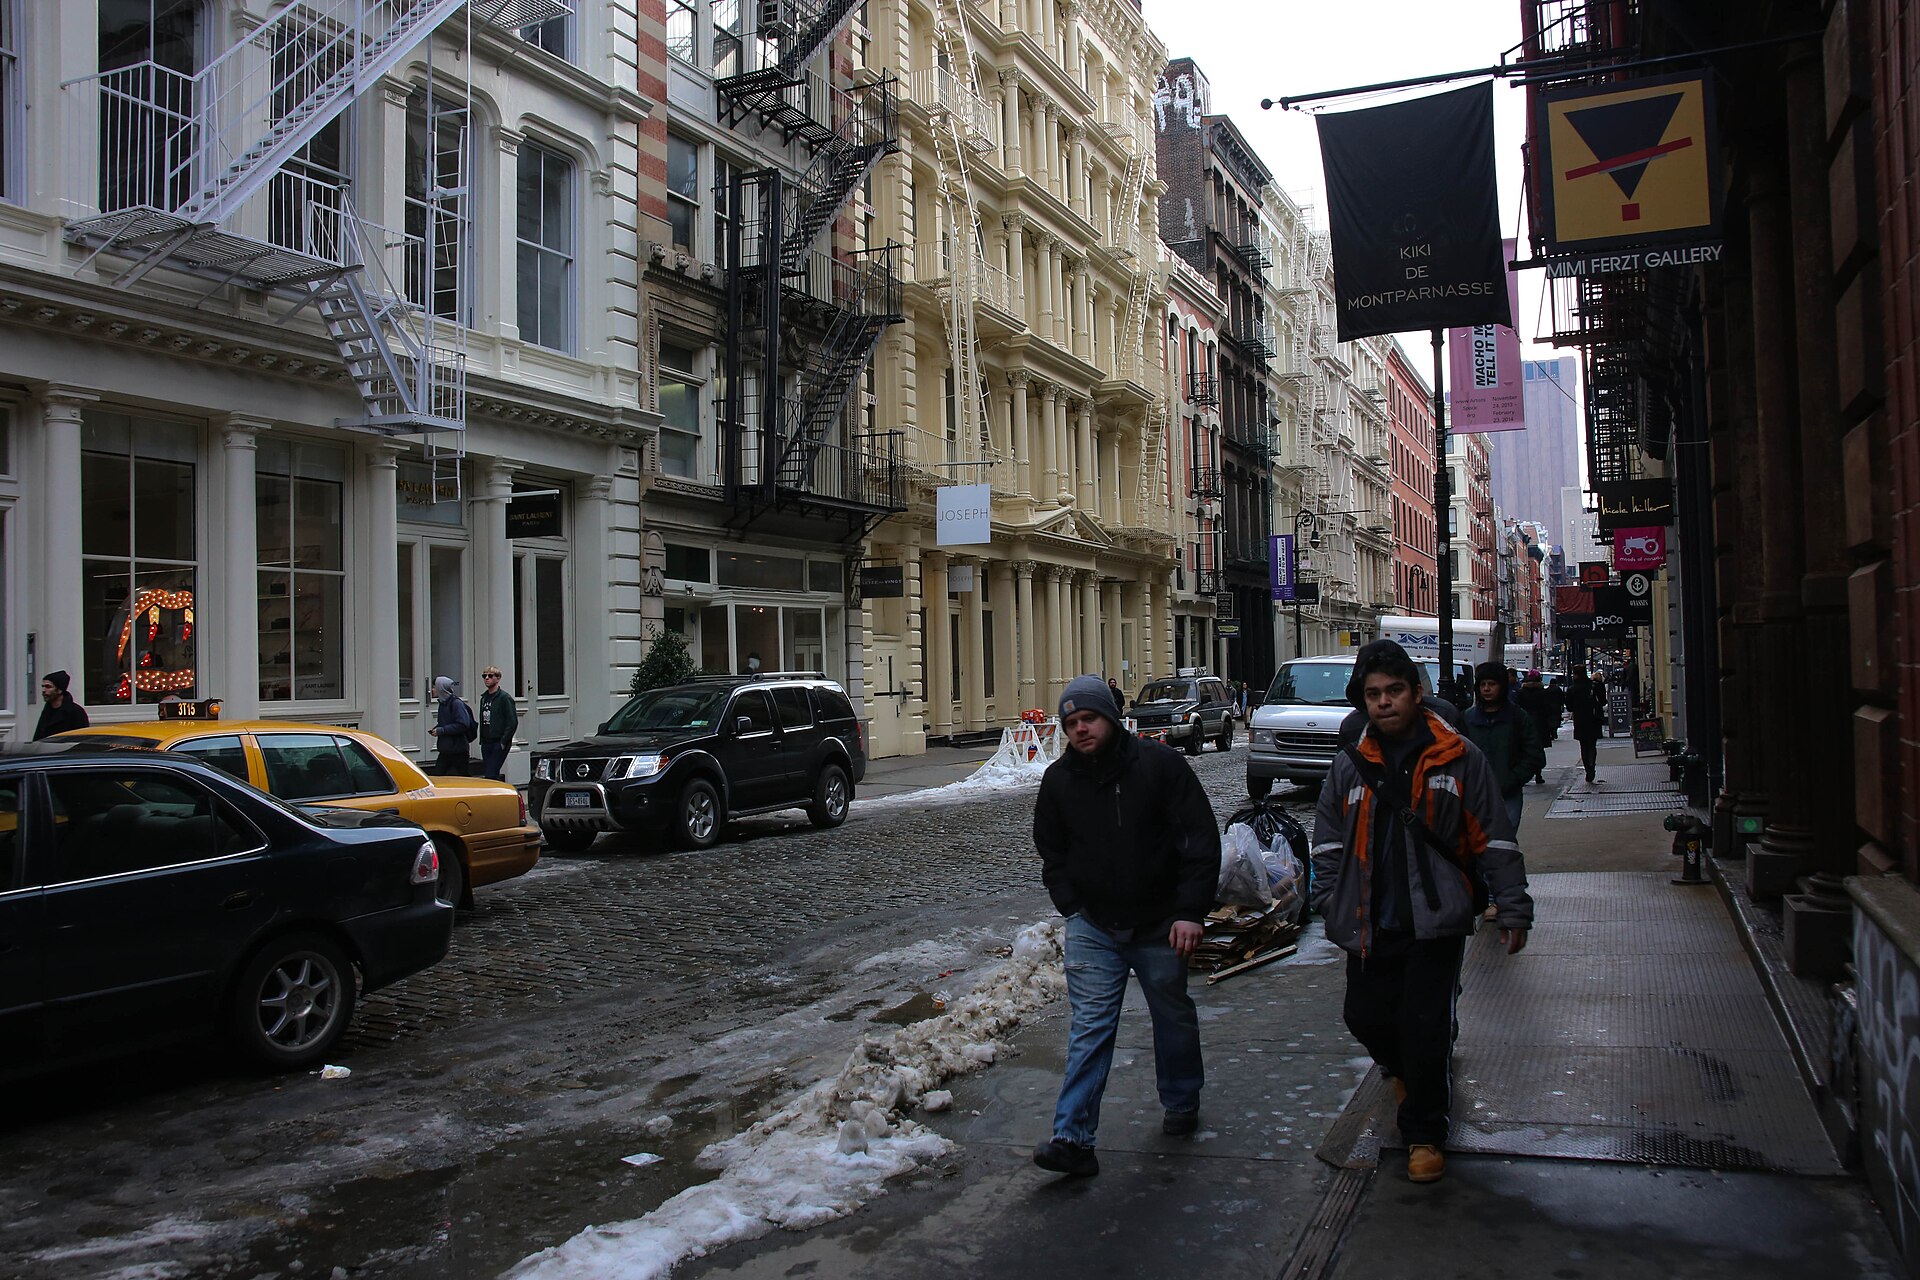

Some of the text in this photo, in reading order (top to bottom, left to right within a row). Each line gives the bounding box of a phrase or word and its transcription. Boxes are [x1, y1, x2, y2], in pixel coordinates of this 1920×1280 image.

[1400, 243, 1431, 260] KIKI
[1546, 244, 1723, 278] MIMI FERZT GALLERY
[1405, 265, 1429, 280] DE
[1347, 282, 1494, 311] MONTPARNASSE
[1484, 322, 1497, 386] TELL IT TO
[1474, 340, 1486, 386] MACHO
[940, 507, 989, 522] JOSEPH
[1595, 615, 1624, 626] BoCo
[177, 701, 196, 717] 3T15
